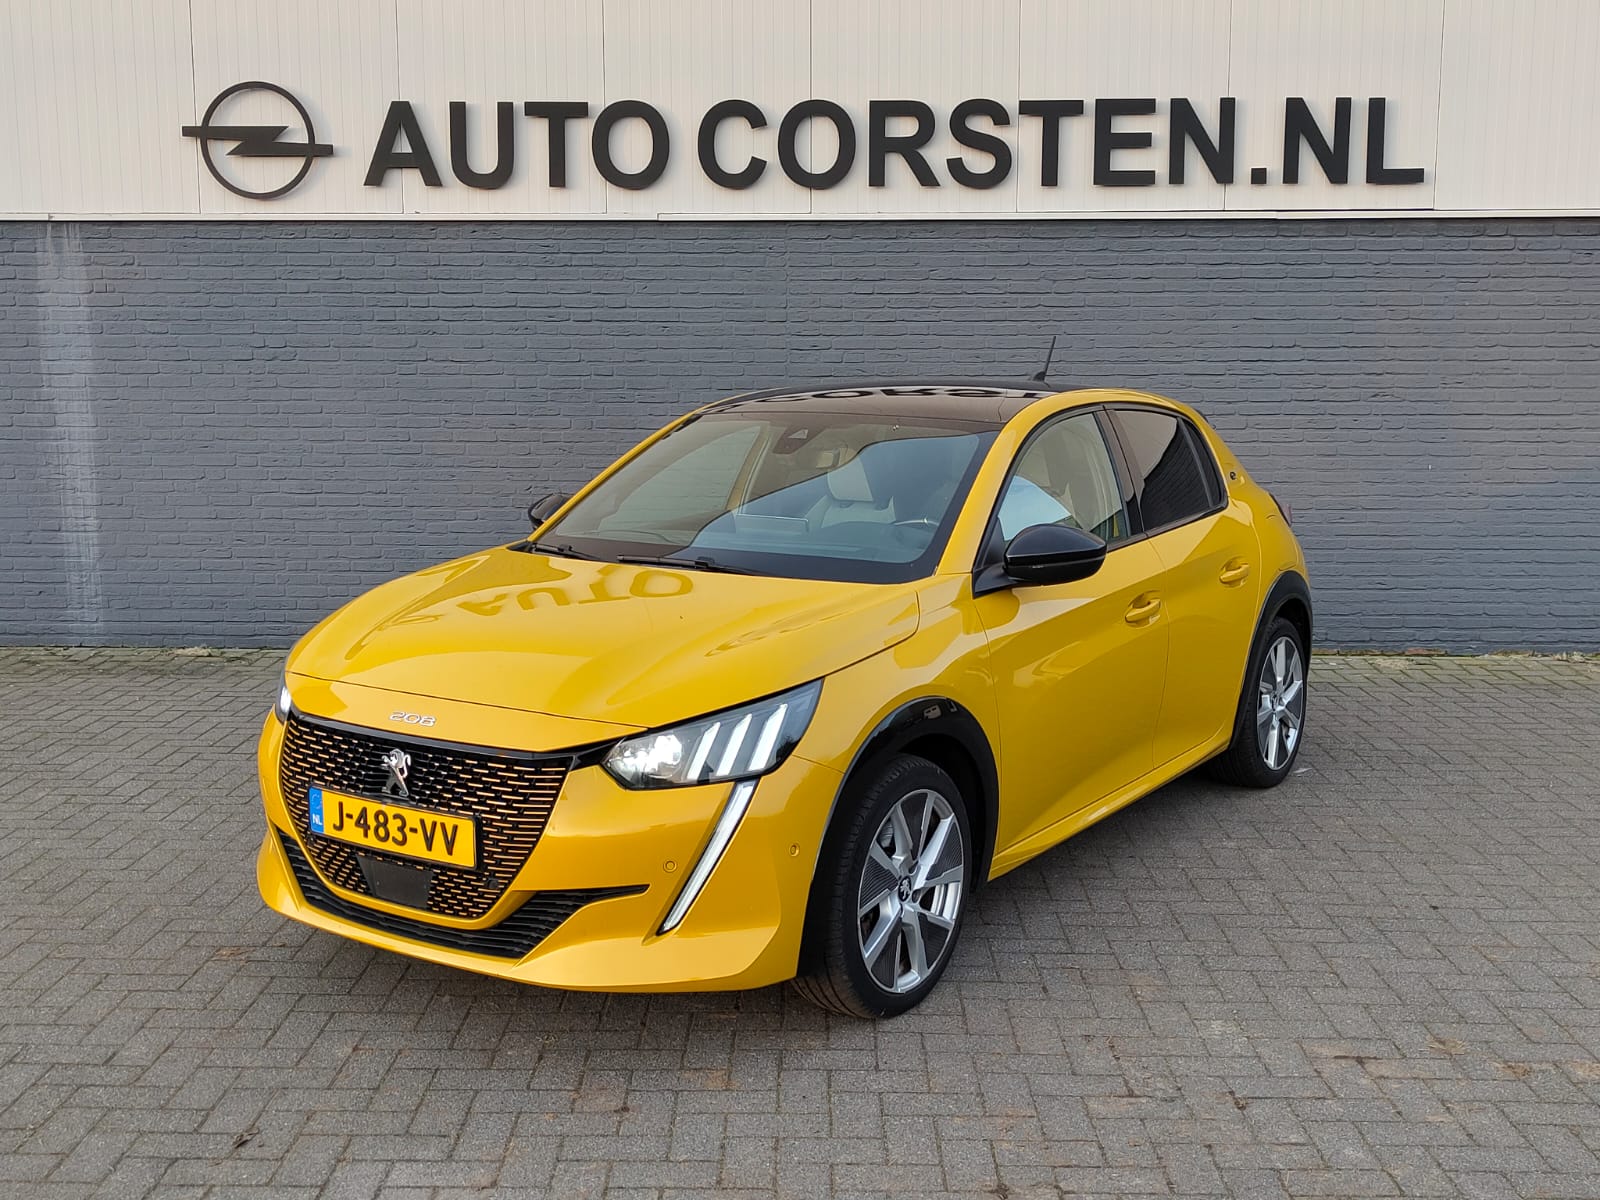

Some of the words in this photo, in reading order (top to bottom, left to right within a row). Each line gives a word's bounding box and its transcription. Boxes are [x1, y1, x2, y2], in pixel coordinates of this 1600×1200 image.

[364, 99, 670, 191] AUTO
[698, 97, 1425, 191] CORSTEN.NL
[389, 710, 436, 727] 208
[312, 814, 322, 826] NL
[333, 801, 458, 856] J-483-VV
